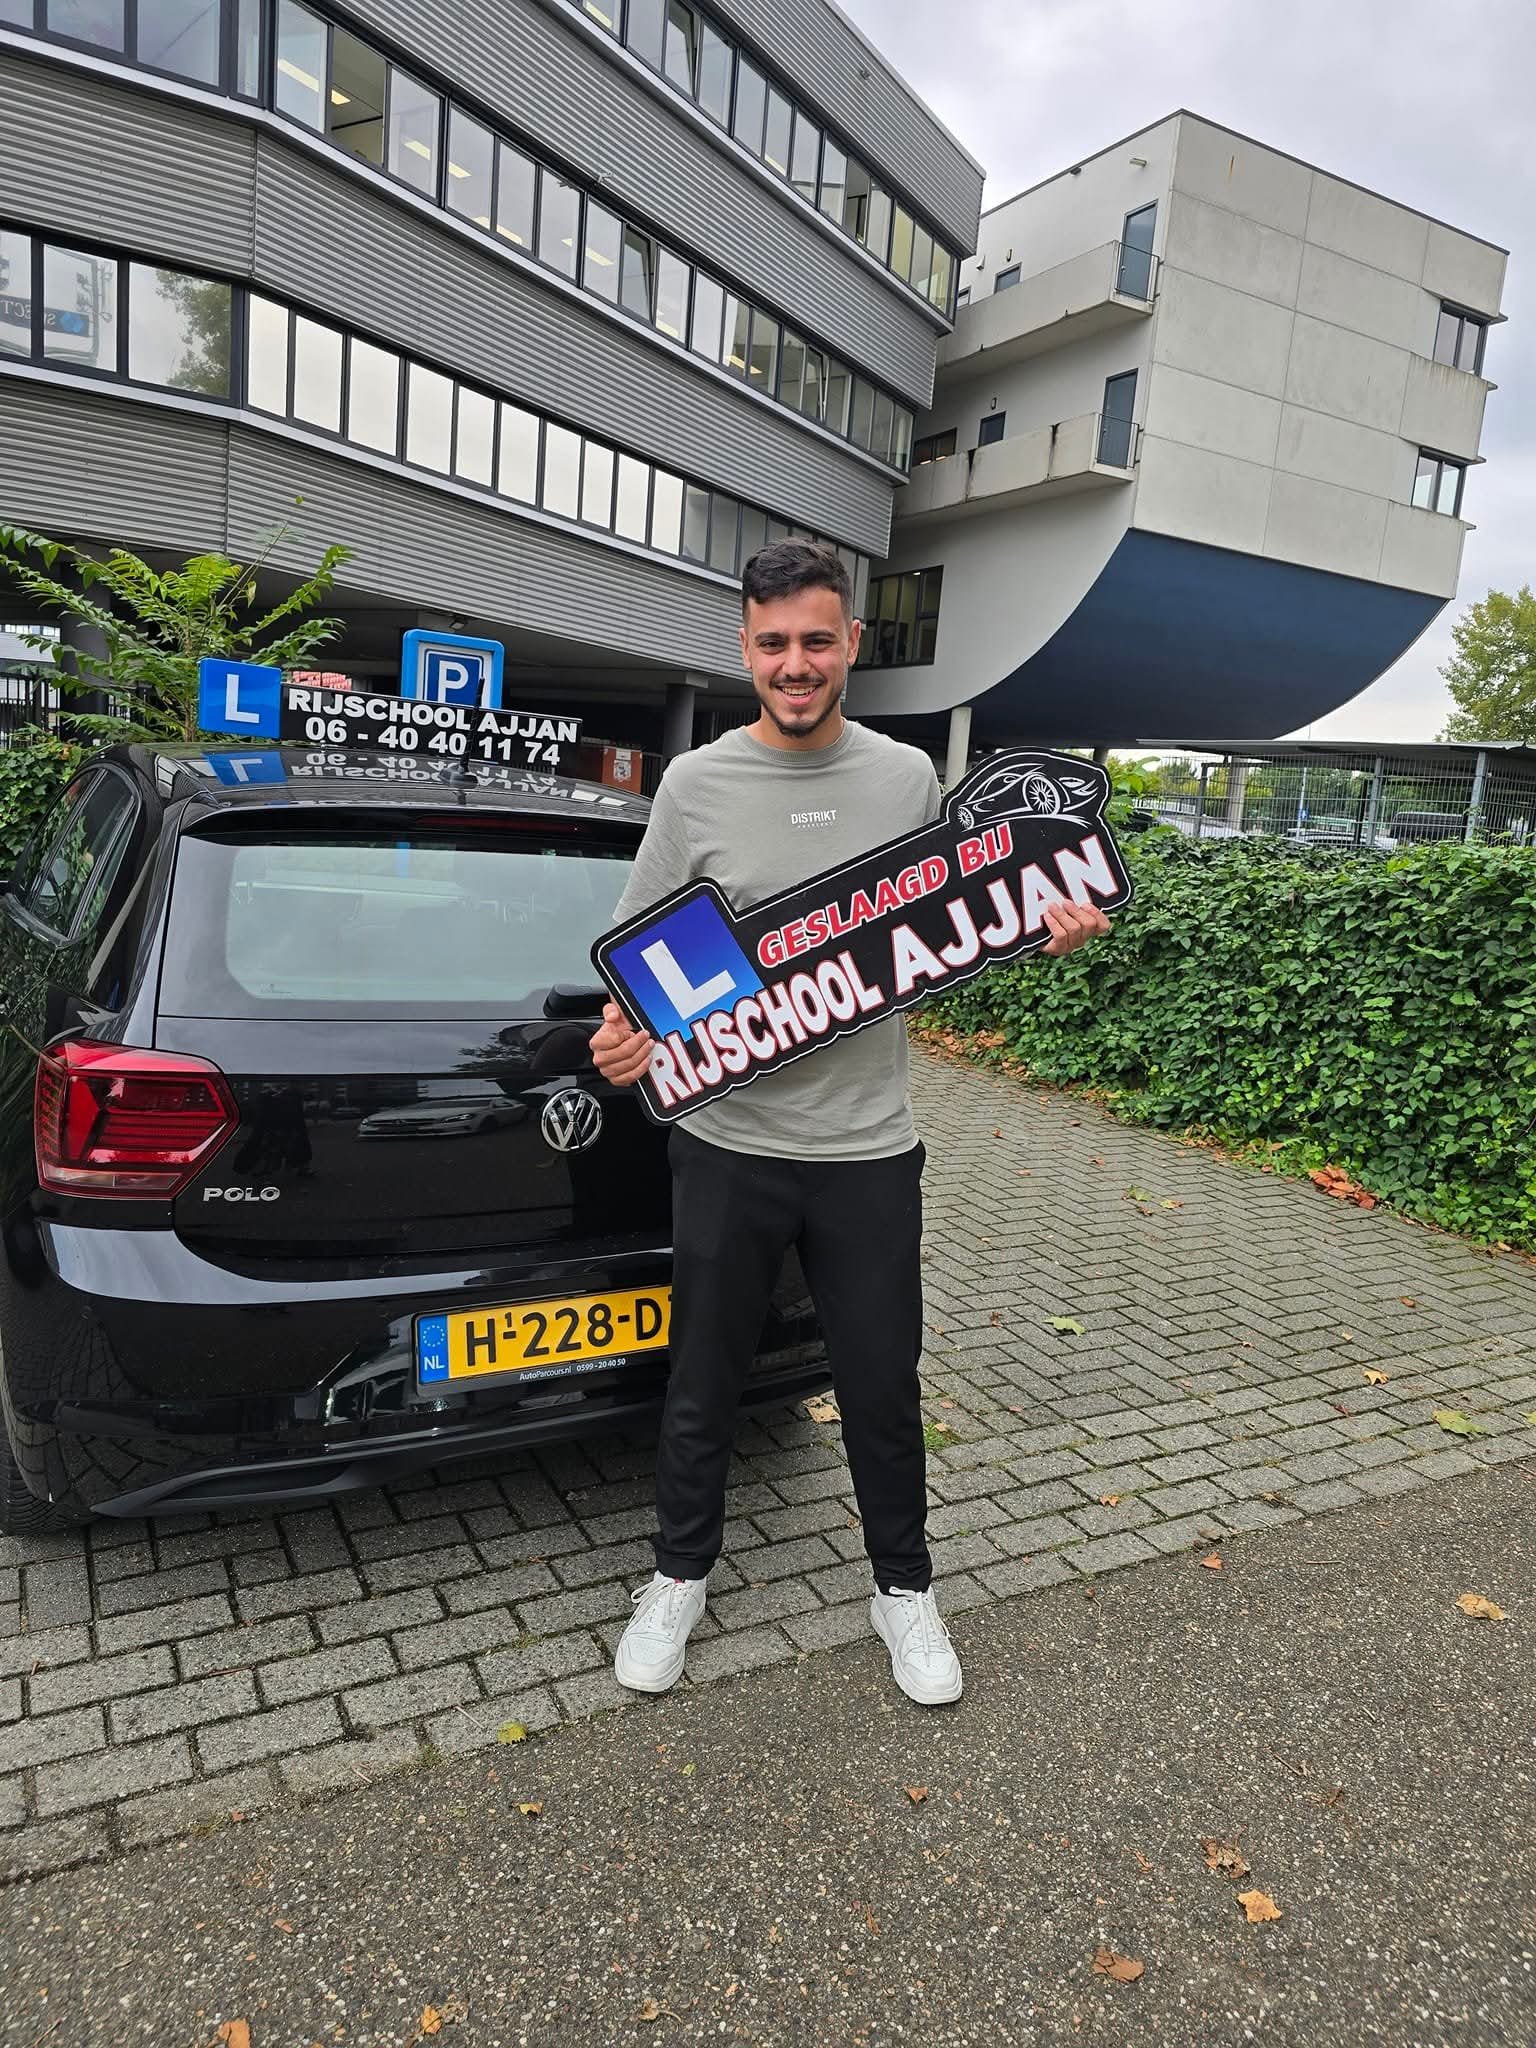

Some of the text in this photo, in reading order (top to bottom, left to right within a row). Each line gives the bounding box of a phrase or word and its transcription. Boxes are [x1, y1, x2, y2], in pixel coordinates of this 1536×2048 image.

[225, 674, 260, 723] L
[438, 660, 470, 703] P
[288, 688, 577, 743] RIJSCHOOL AJJAN
[305, 716, 347, 742] 06
[378, 725, 419, 750] 40
[428, 731, 467, 756] 40
[479, 736, 511, 760] 11
[524, 741, 560, 765] 74
[791, 809, 837, 825] DISTRIKT
[757, 821, 1014, 968] GESLAAGD BIJ
[640, 939, 737, 1021] L
[648, 834, 1119, 1108] RIJSCHOOL AJJAN
[202, 1186, 280, 1202] POLO
[423, 1355, 445, 1371] NL
[519, 1365, 572, 1381] AutoParcours.nl
[576, 1362, 594, 1372] 0599
[598, 1361, 607, 1369] 20
[608, 1359, 617, 1368] 40
[617, 1357, 626, 1366] 50
